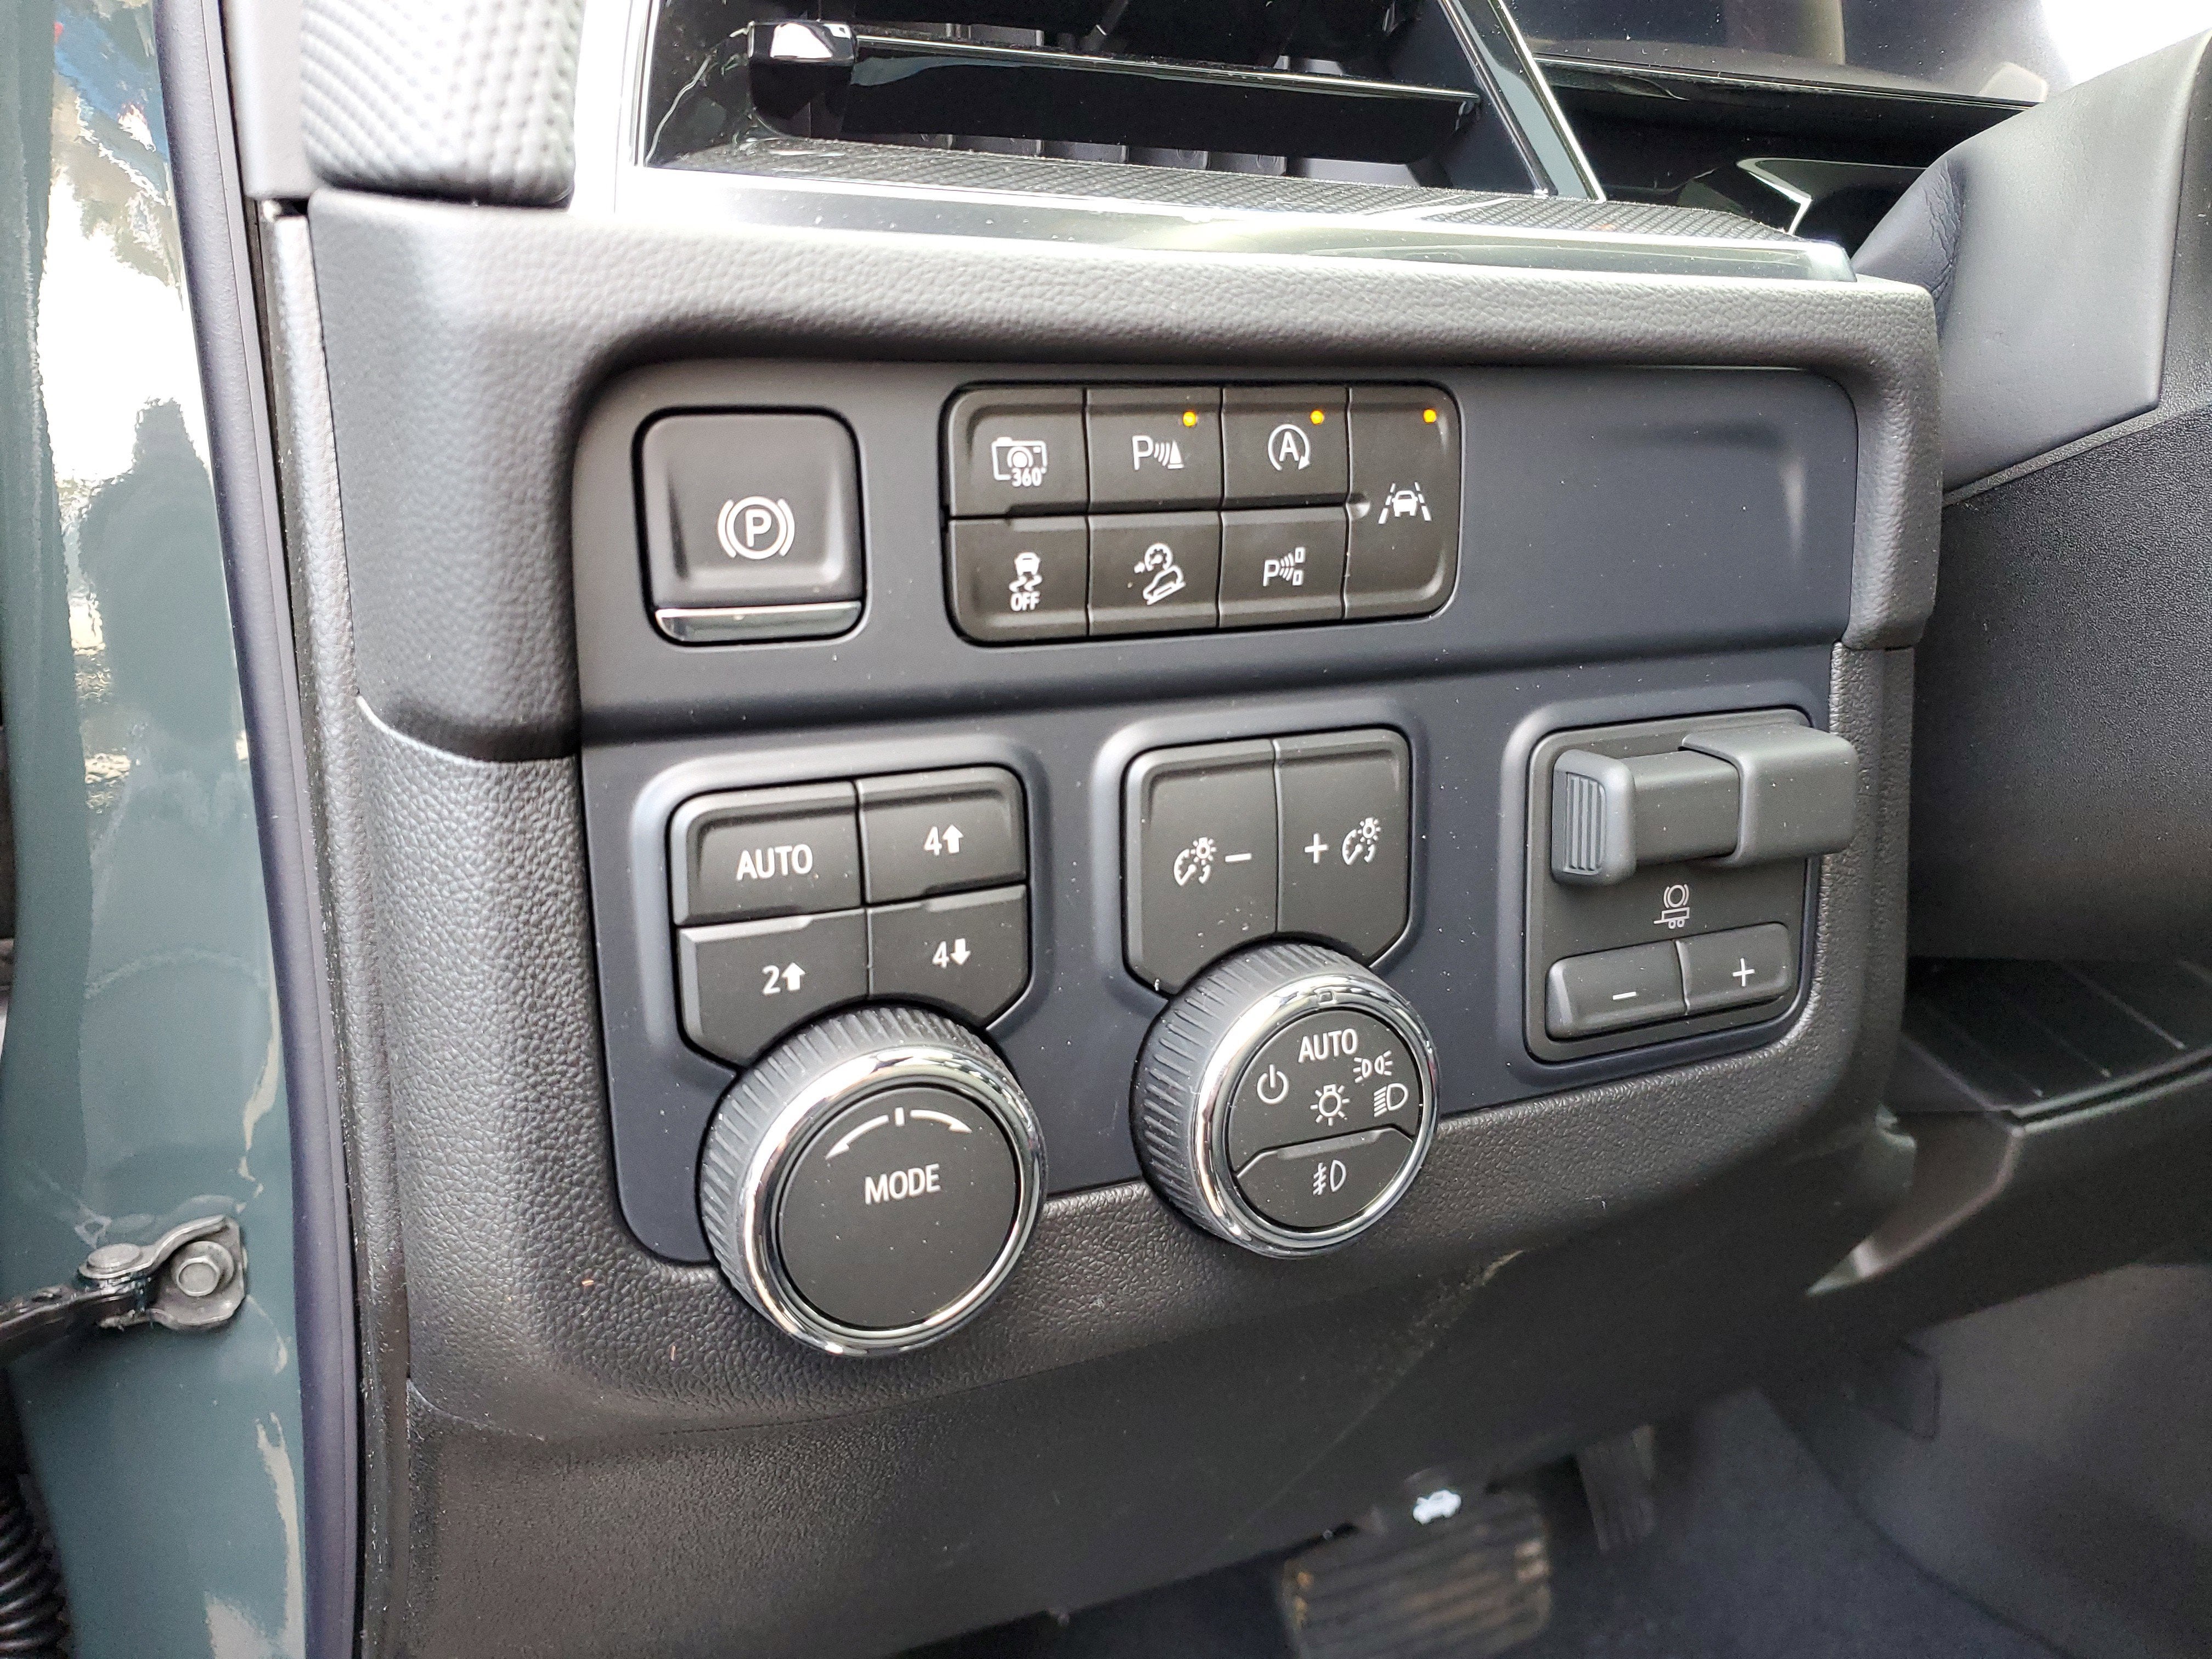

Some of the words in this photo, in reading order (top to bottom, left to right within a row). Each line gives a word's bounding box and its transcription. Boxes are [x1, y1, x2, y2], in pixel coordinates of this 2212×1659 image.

[1132, 435, 1153, 470] P
[1279, 431, 1300, 462] A
[745, 509, 772, 548] P
[1262, 559, 1280, 587] P
[1010, 591, 1041, 612] OFF
[736, 843, 814, 881] AUTO
[1298, 1028, 1358, 1063] AUTO
[864, 1163, 941, 1205] MODE
